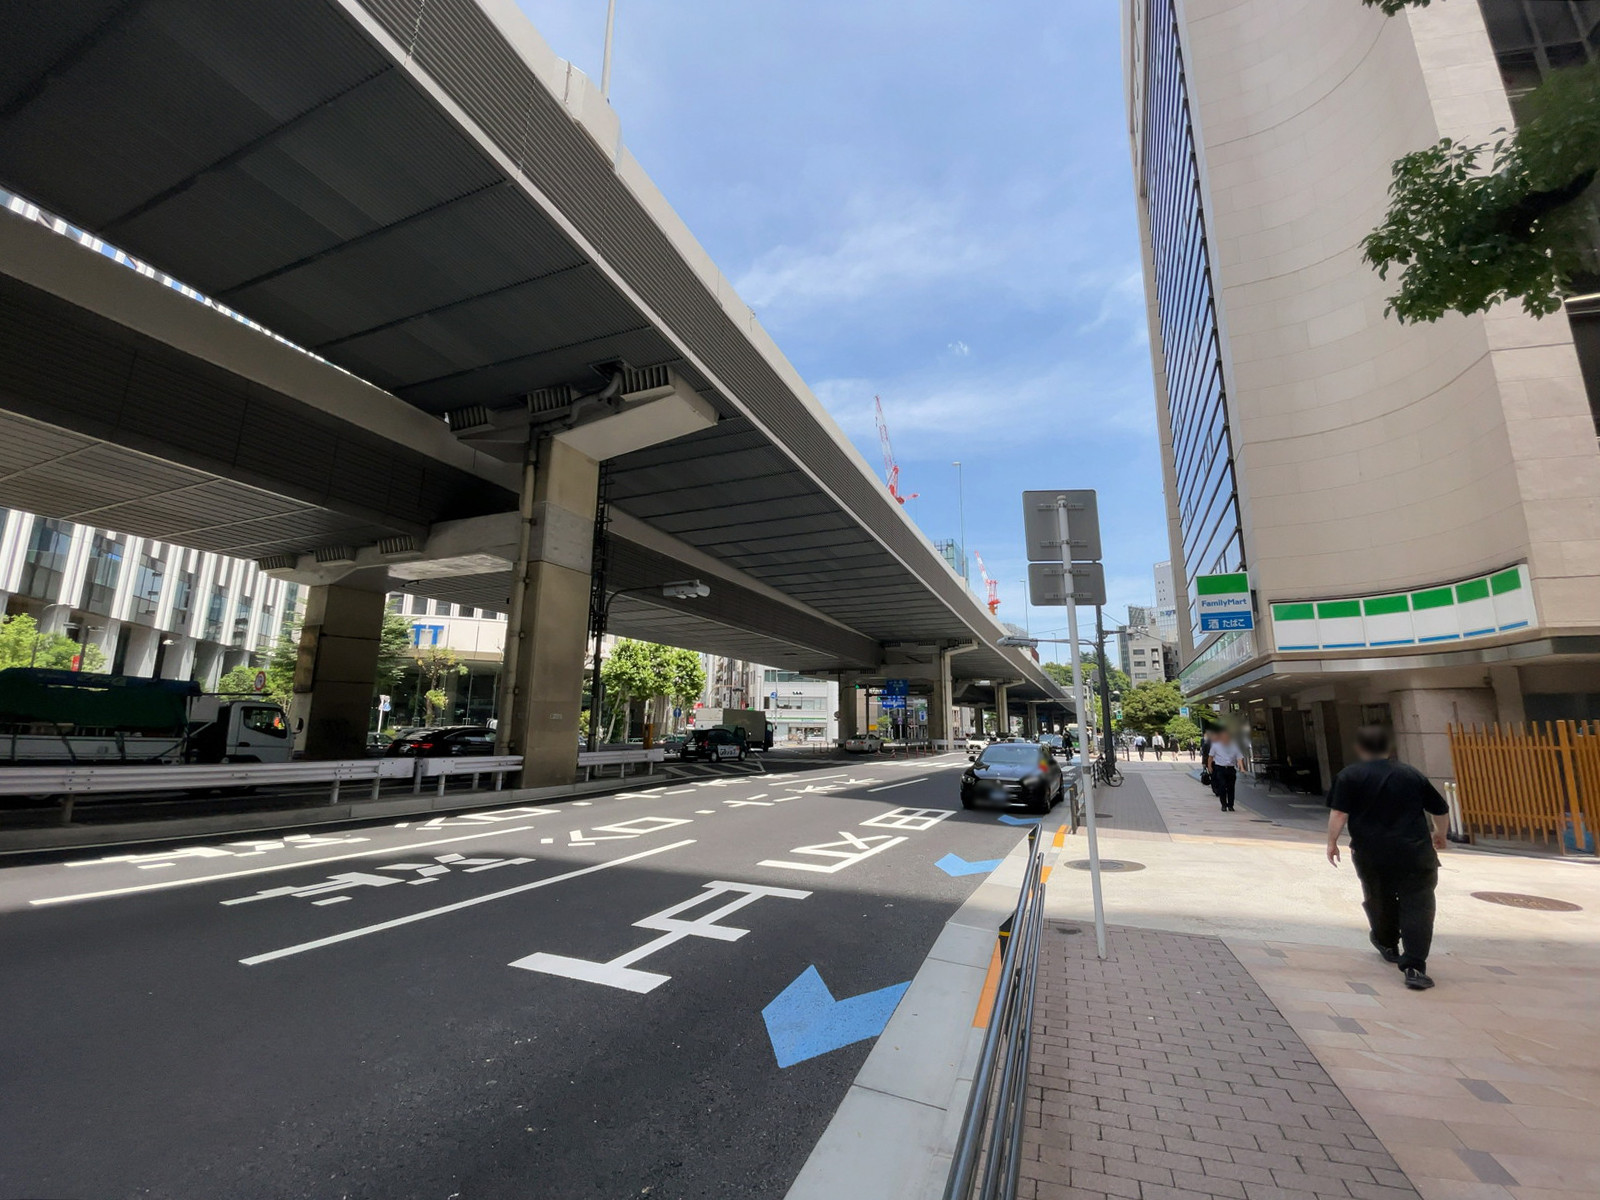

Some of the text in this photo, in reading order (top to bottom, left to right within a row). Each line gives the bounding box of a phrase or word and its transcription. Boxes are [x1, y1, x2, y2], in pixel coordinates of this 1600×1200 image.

[1201, 598, 1247, 607] FamilyMart
[1208, 619, 1246, 629] 酒 たばこ
[404, 624, 444, 646] TT
